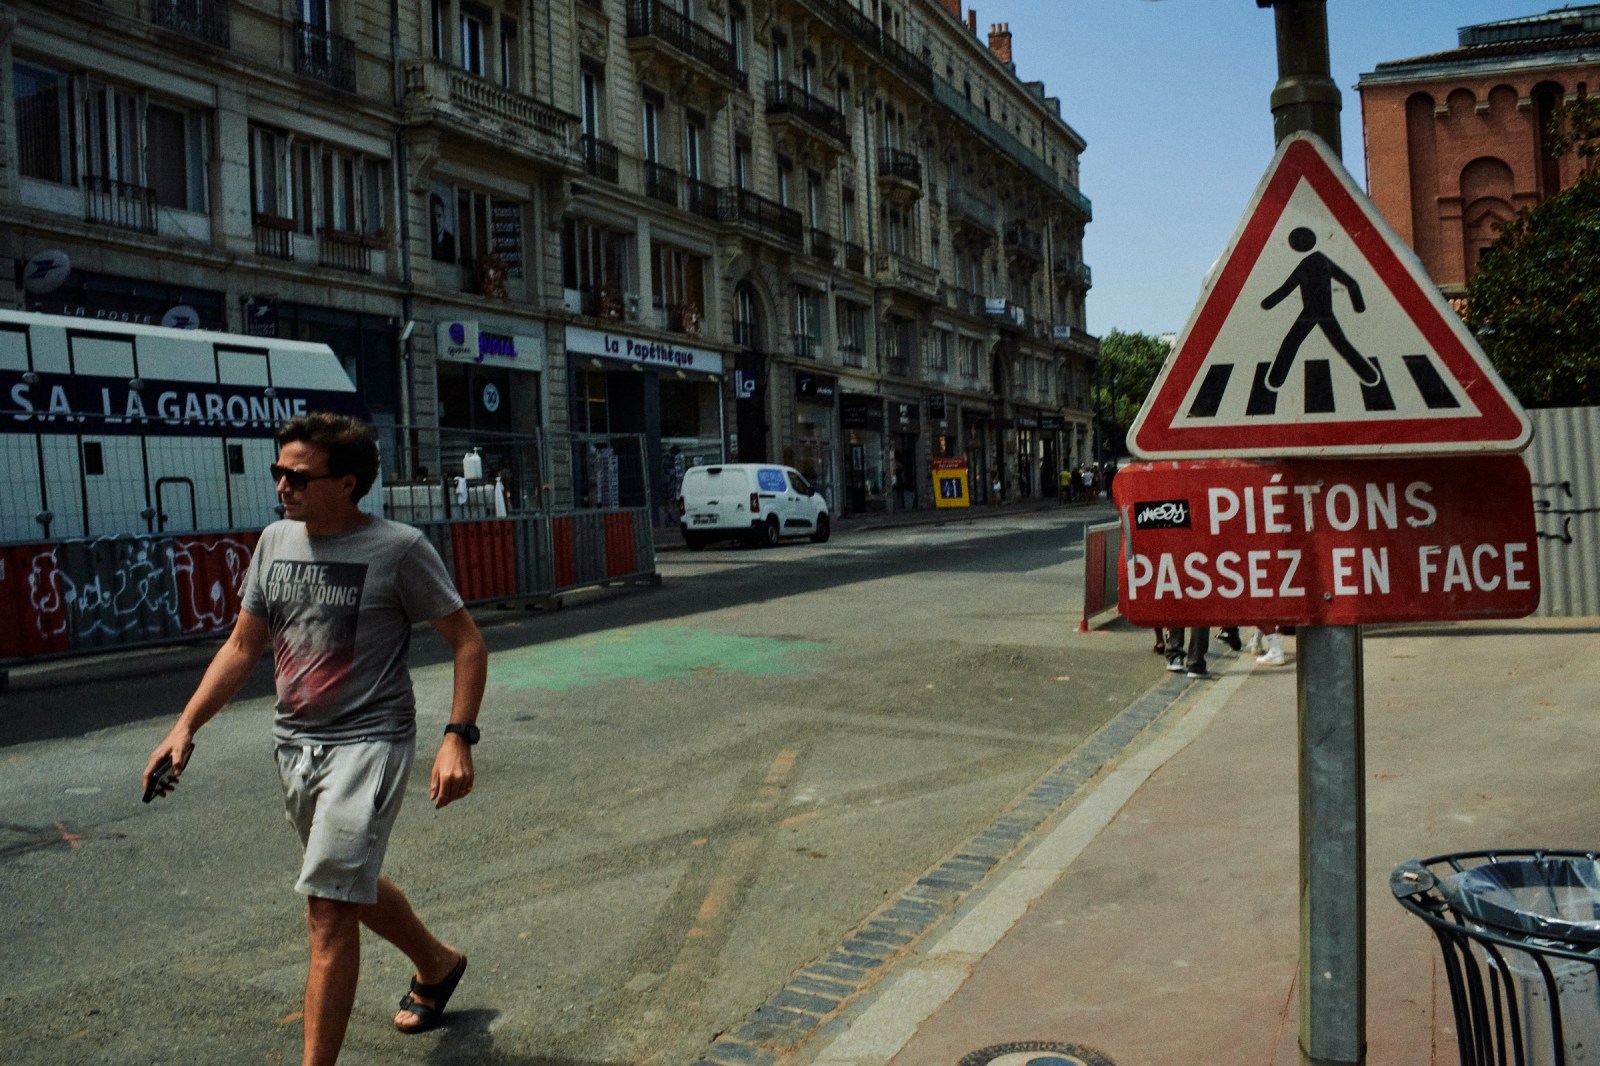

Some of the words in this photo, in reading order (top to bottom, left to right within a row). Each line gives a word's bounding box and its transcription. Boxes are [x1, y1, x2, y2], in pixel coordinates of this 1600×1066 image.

[63, 304, 86, 318] LA
[96, 309, 152, 324] POSTE
[604, 335, 619, 352] La
[626, 339, 693, 366] Papéthèque
[101, 386, 147, 424] LA
[1207, 473, 1438, 535] PIÉTONS
[270, 563, 292, 583] TOO
[294, 564, 328, 584] LATE
[1127, 549, 1306, 600] PASSEZ
[1332, 546, 1389, 596] EN
[1418, 542, 1532, 594] FACE
[268, 581, 280, 602] TO
[281, 582, 304, 602] DIE
[310, 583, 358, 606] YOUNG
